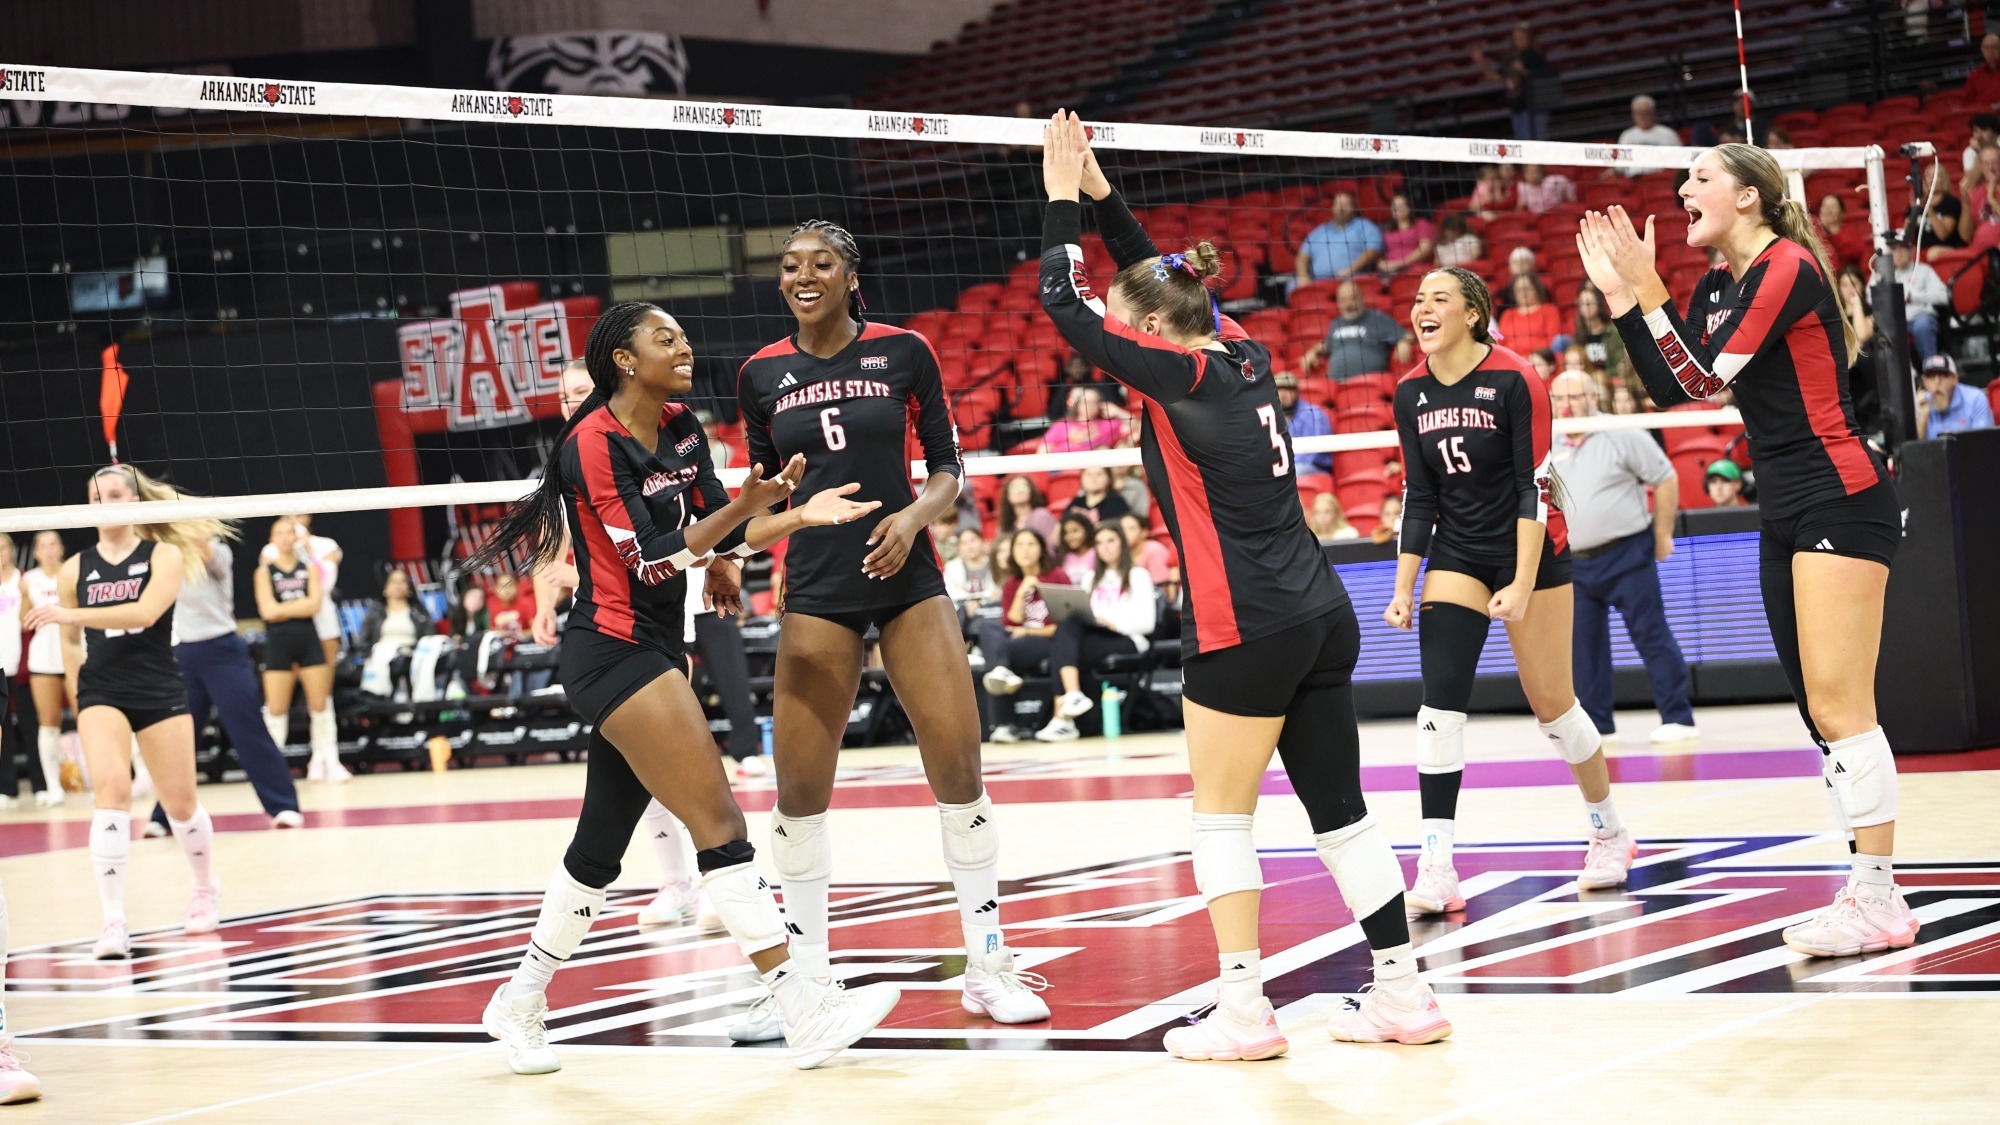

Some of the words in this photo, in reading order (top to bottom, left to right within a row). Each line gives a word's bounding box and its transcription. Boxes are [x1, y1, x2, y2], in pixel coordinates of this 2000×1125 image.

[6, 70, 45, 92] STATE
[200, 80, 264, 103] ARKANSAS
[280, 85, 316, 106] STATE
[451, 94, 508, 115] ARKANSAS
[523, 98, 553, 117] STATE
[673, 106, 723, 125] ARKANSAS
[735, 109, 762, 127] STATE
[868, 115, 912, 133] ARKANSAS
[924, 118, 949, 135] STATE
[1093, 126, 1116, 142] STATE
[398, 284, 574, 432] STATE
[1656, 330, 1689, 369] RED
[860, 356, 888, 370] SBC
[773, 380, 842, 415] ARKANSAS
[1474, 386, 1497, 401] SBC
[820, 407, 847, 451] 6
[1256, 403, 1290, 477] 3
[674, 433, 699, 457] SBC
[1437, 436, 1472, 475] 15
[641, 560, 680, 587] TATE
[87, 577, 143, 605] TROY
